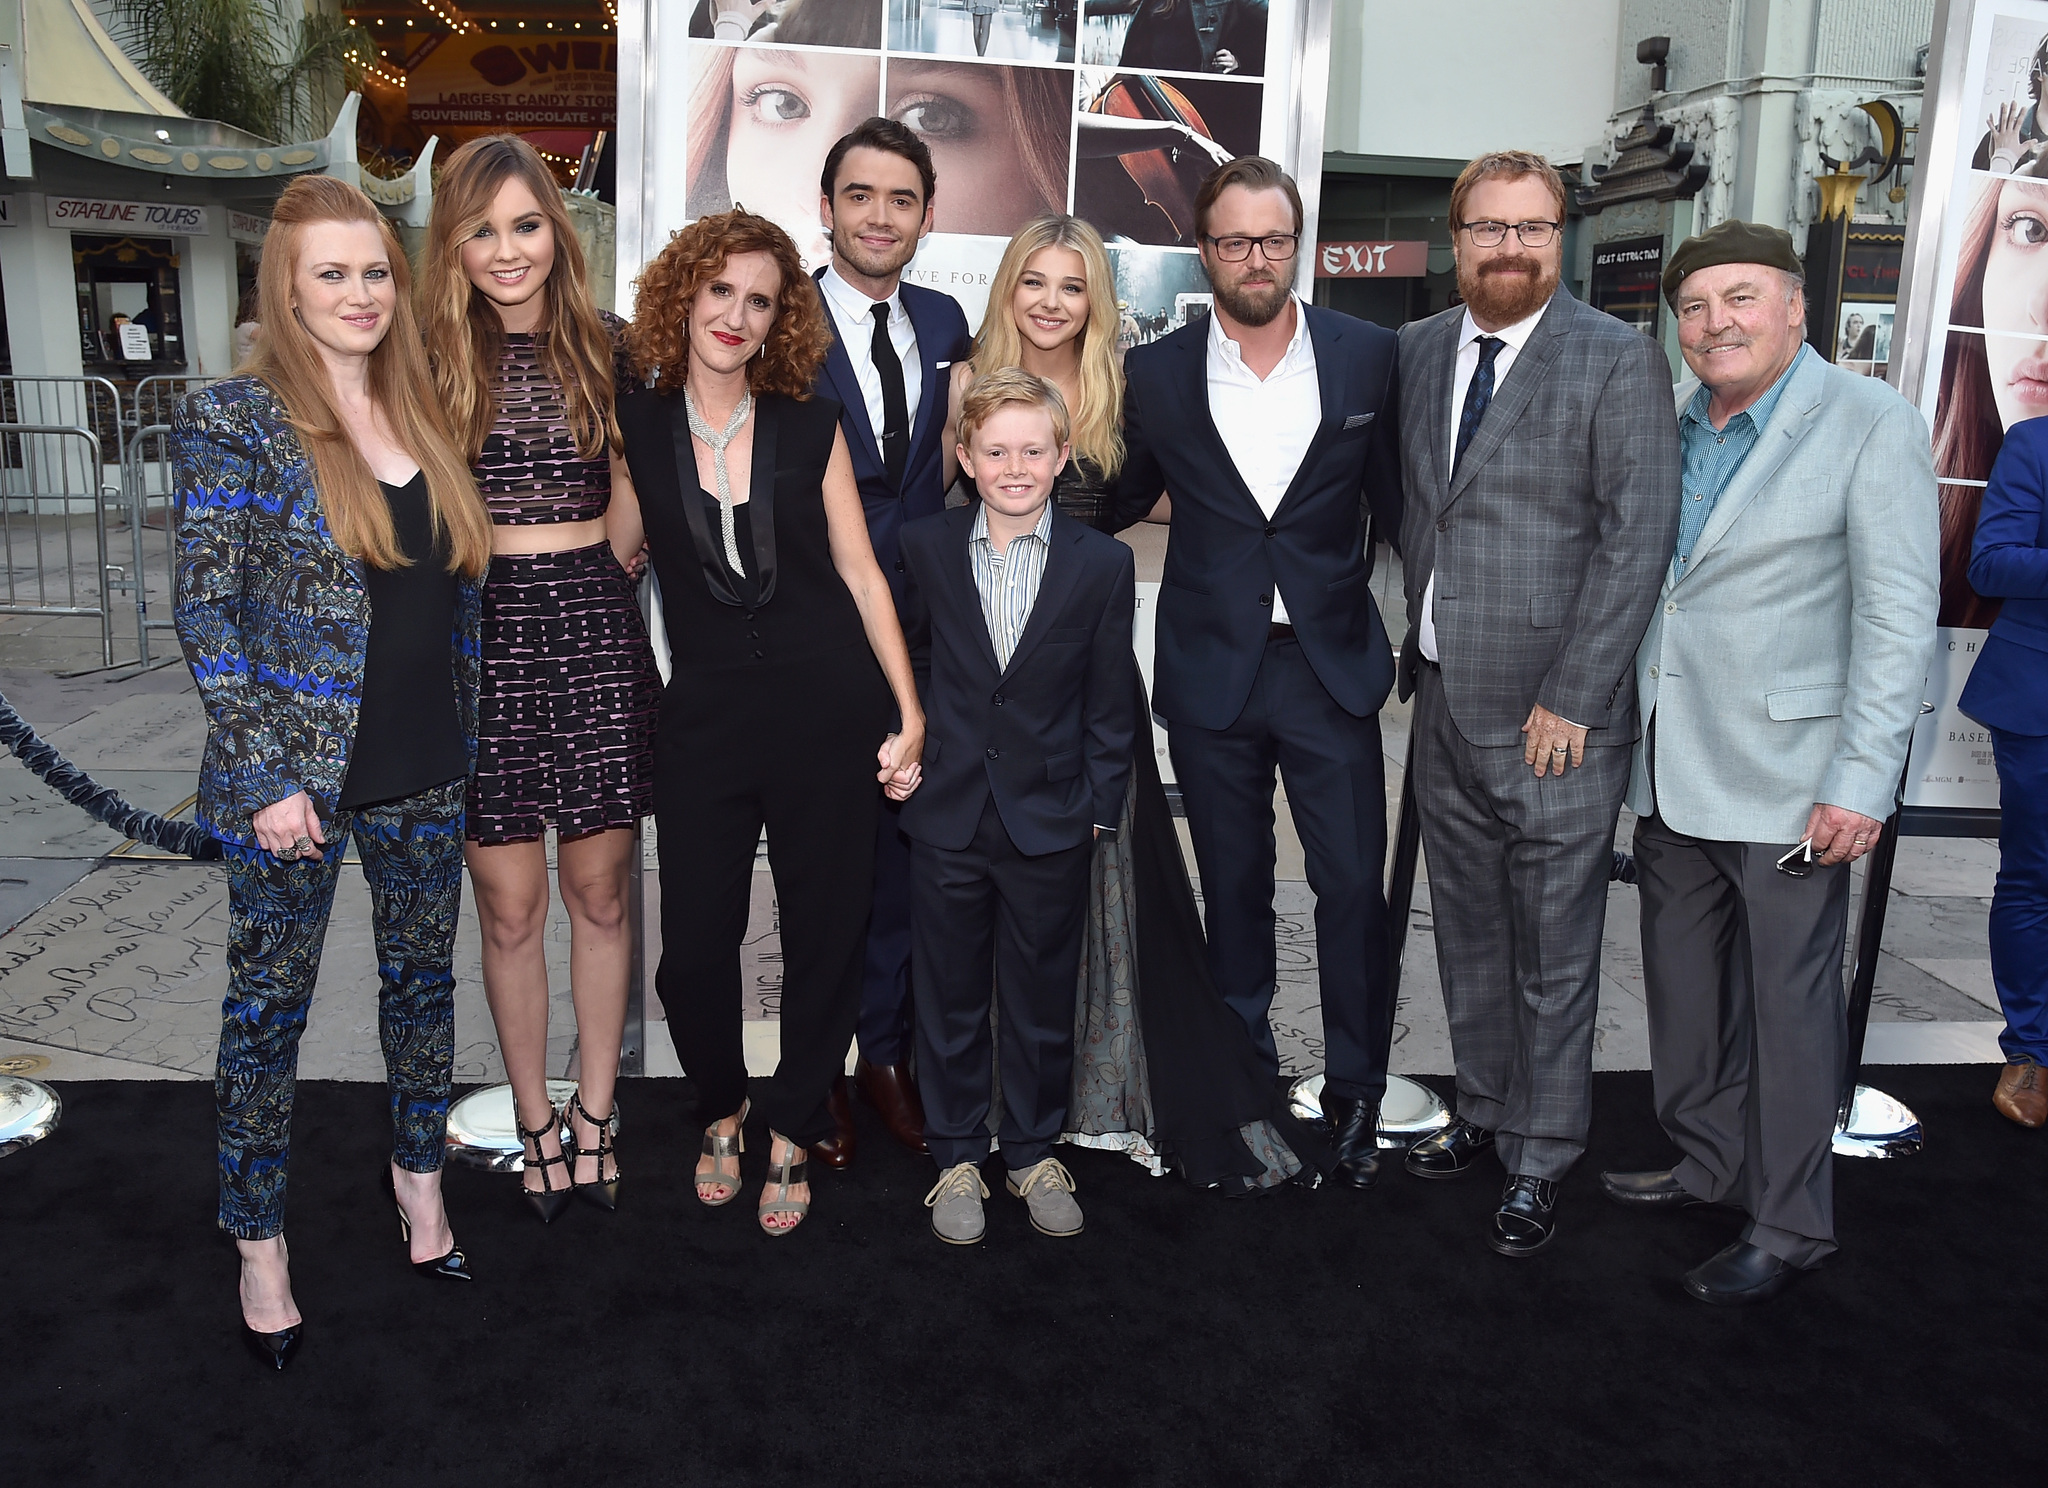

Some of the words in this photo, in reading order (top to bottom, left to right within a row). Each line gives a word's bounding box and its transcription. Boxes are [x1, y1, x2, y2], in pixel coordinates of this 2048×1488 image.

[438, 92, 511, 106] LARGEST
[516, 93, 571, 107] CANDY
[575, 95, 616, 107] STOR
[411, 109, 492, 121] SOUVENIRS
[505, 110, 588, 123] CHOCOLATE
[55, 200, 140, 222] STARLINE
[144, 205, 201, 226] TOURS
[1322, 244, 1395, 275] EXIT
[1616, 248, 1660, 263] ATTRACTION
[950, 271, 989, 286] FOR
[1846, 265, 1869, 279] CL
